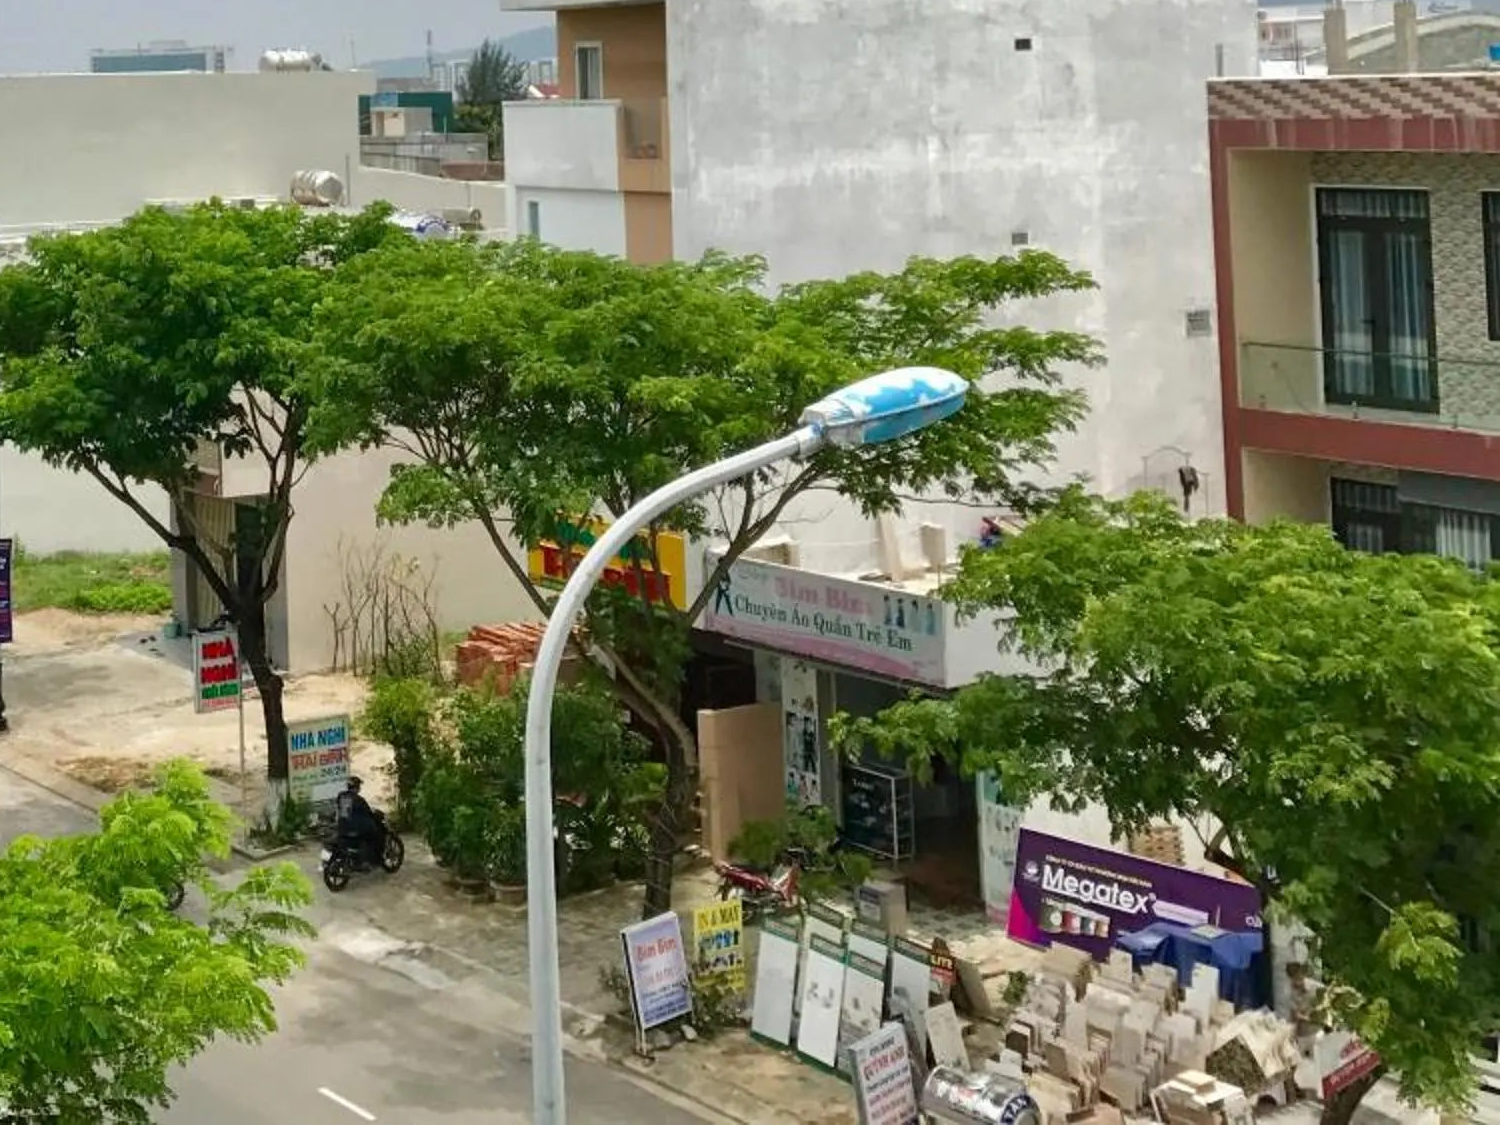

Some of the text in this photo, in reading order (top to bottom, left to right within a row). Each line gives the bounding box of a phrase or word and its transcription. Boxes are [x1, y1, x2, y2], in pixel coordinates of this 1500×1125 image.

[735, 594, 788, 623] Chuyên
[886, 628, 913, 652] Em
[1042, 863, 1150, 915] Megatex
